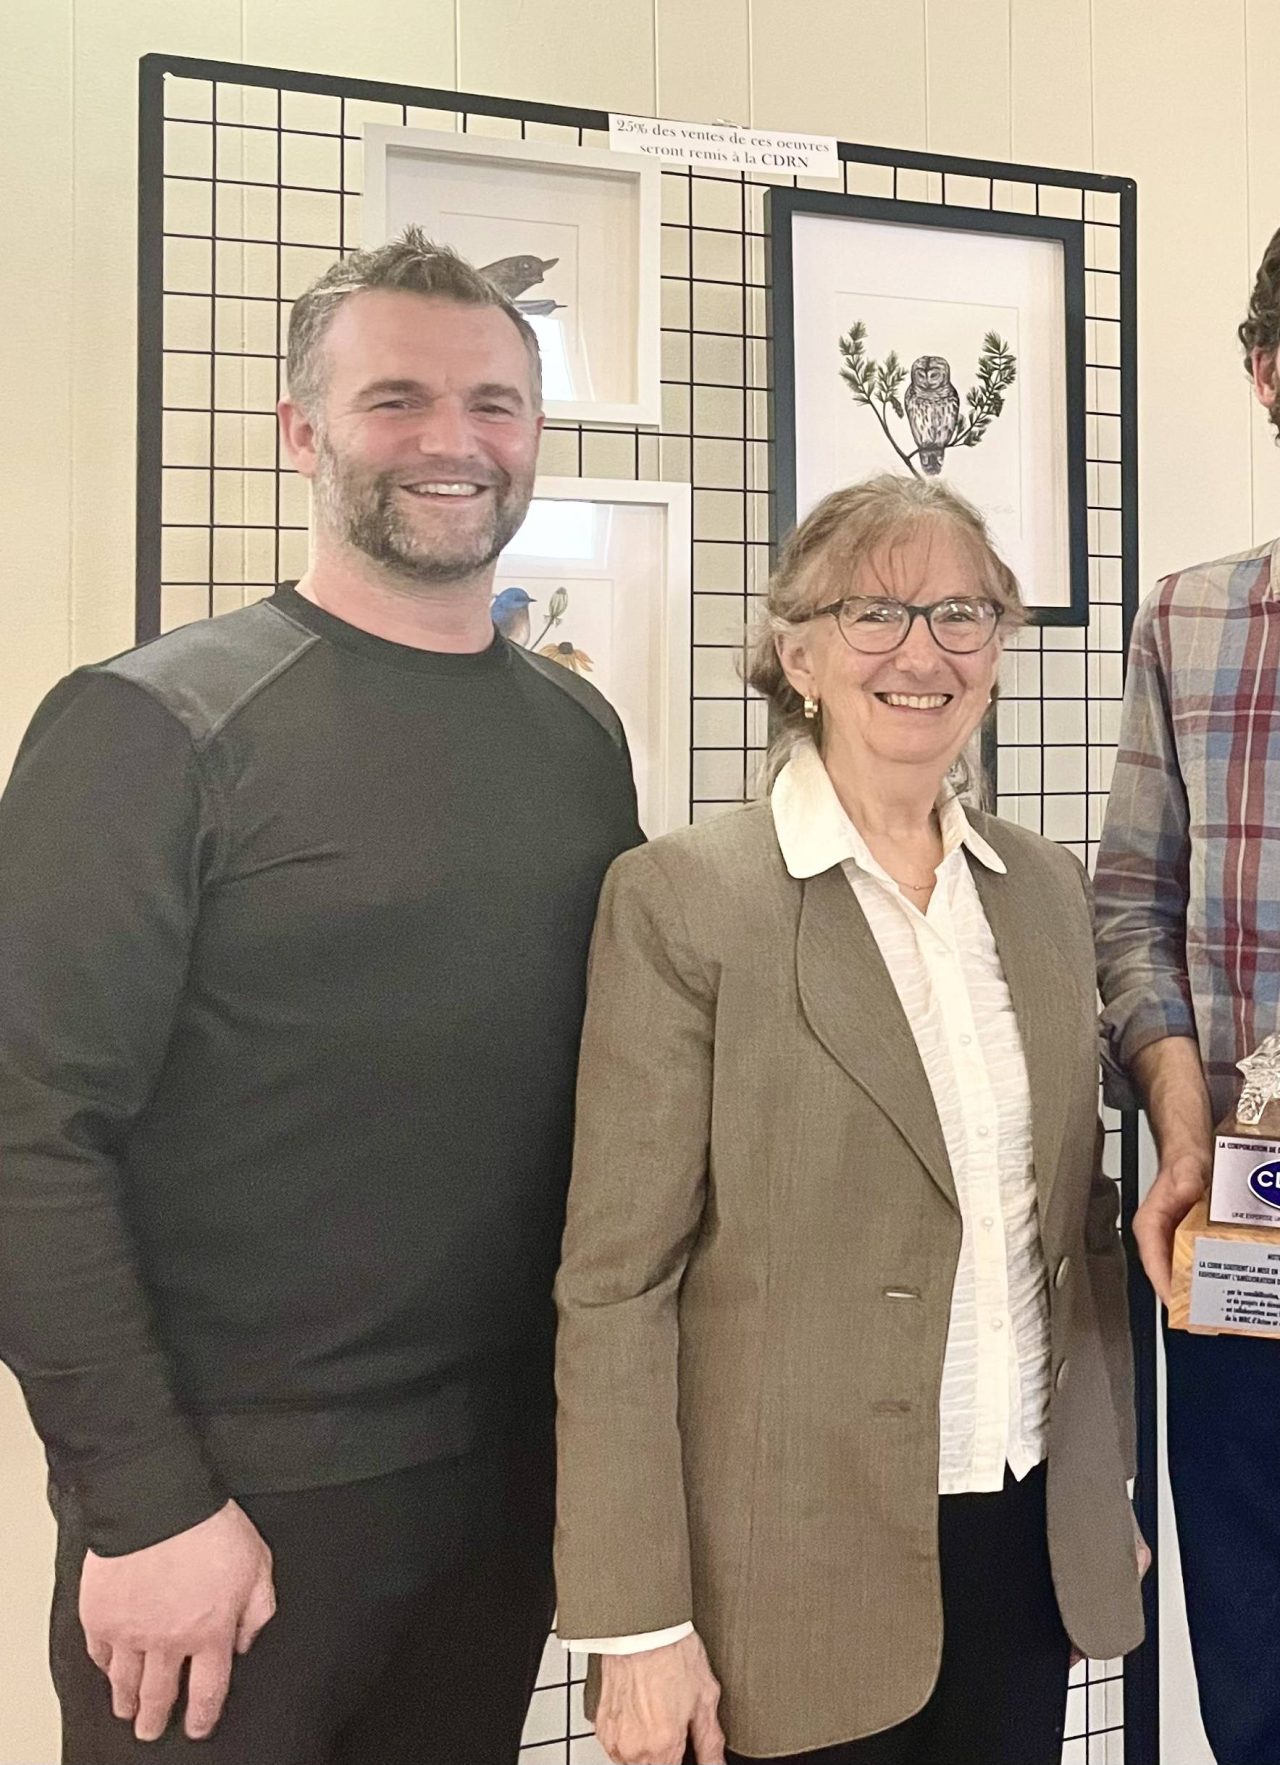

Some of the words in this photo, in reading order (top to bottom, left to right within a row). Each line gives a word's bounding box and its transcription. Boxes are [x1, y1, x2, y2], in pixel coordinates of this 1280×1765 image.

[617, 120, 648, 135] 25%
[652, 124, 677, 138] des
[681, 130, 725, 143] ventes
[729, 132, 746, 145] de
[750, 137, 773, 149] ces
[776, 140, 830, 153] oeuvres
[640, 144, 684, 158] seront
[688, 149, 728, 162] remis
[732, 152, 740, 163] à
[745, 153, 757, 165] la
[761, 153, 809, 169] CDRN
